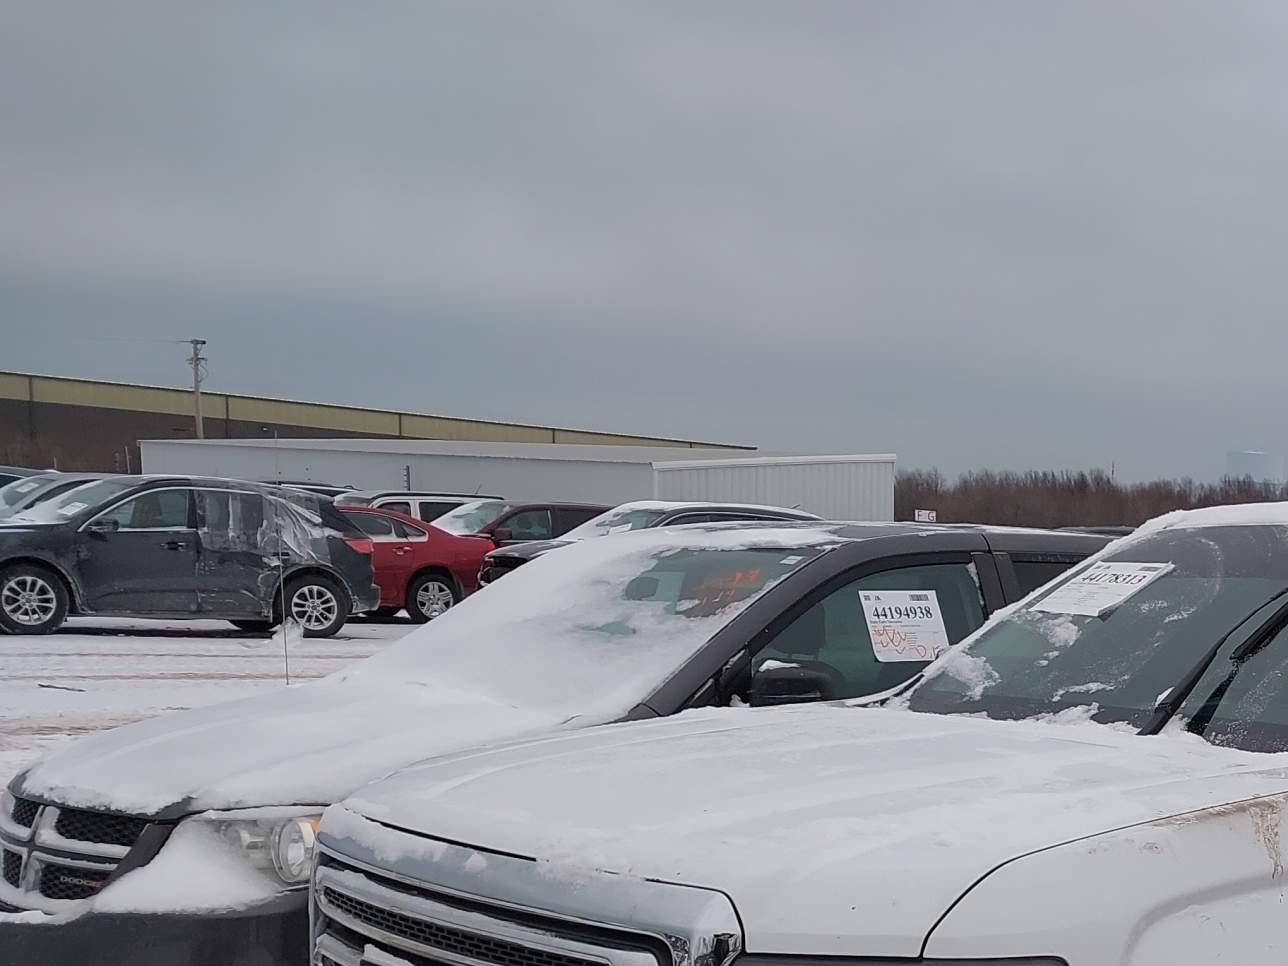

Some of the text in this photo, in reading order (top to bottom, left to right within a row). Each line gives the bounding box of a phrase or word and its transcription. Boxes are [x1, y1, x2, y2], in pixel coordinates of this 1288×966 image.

[917, 510, 935, 521] F G
[1081, 573, 1147, 585] 44178313
[872, 605, 933, 620] 44194938
